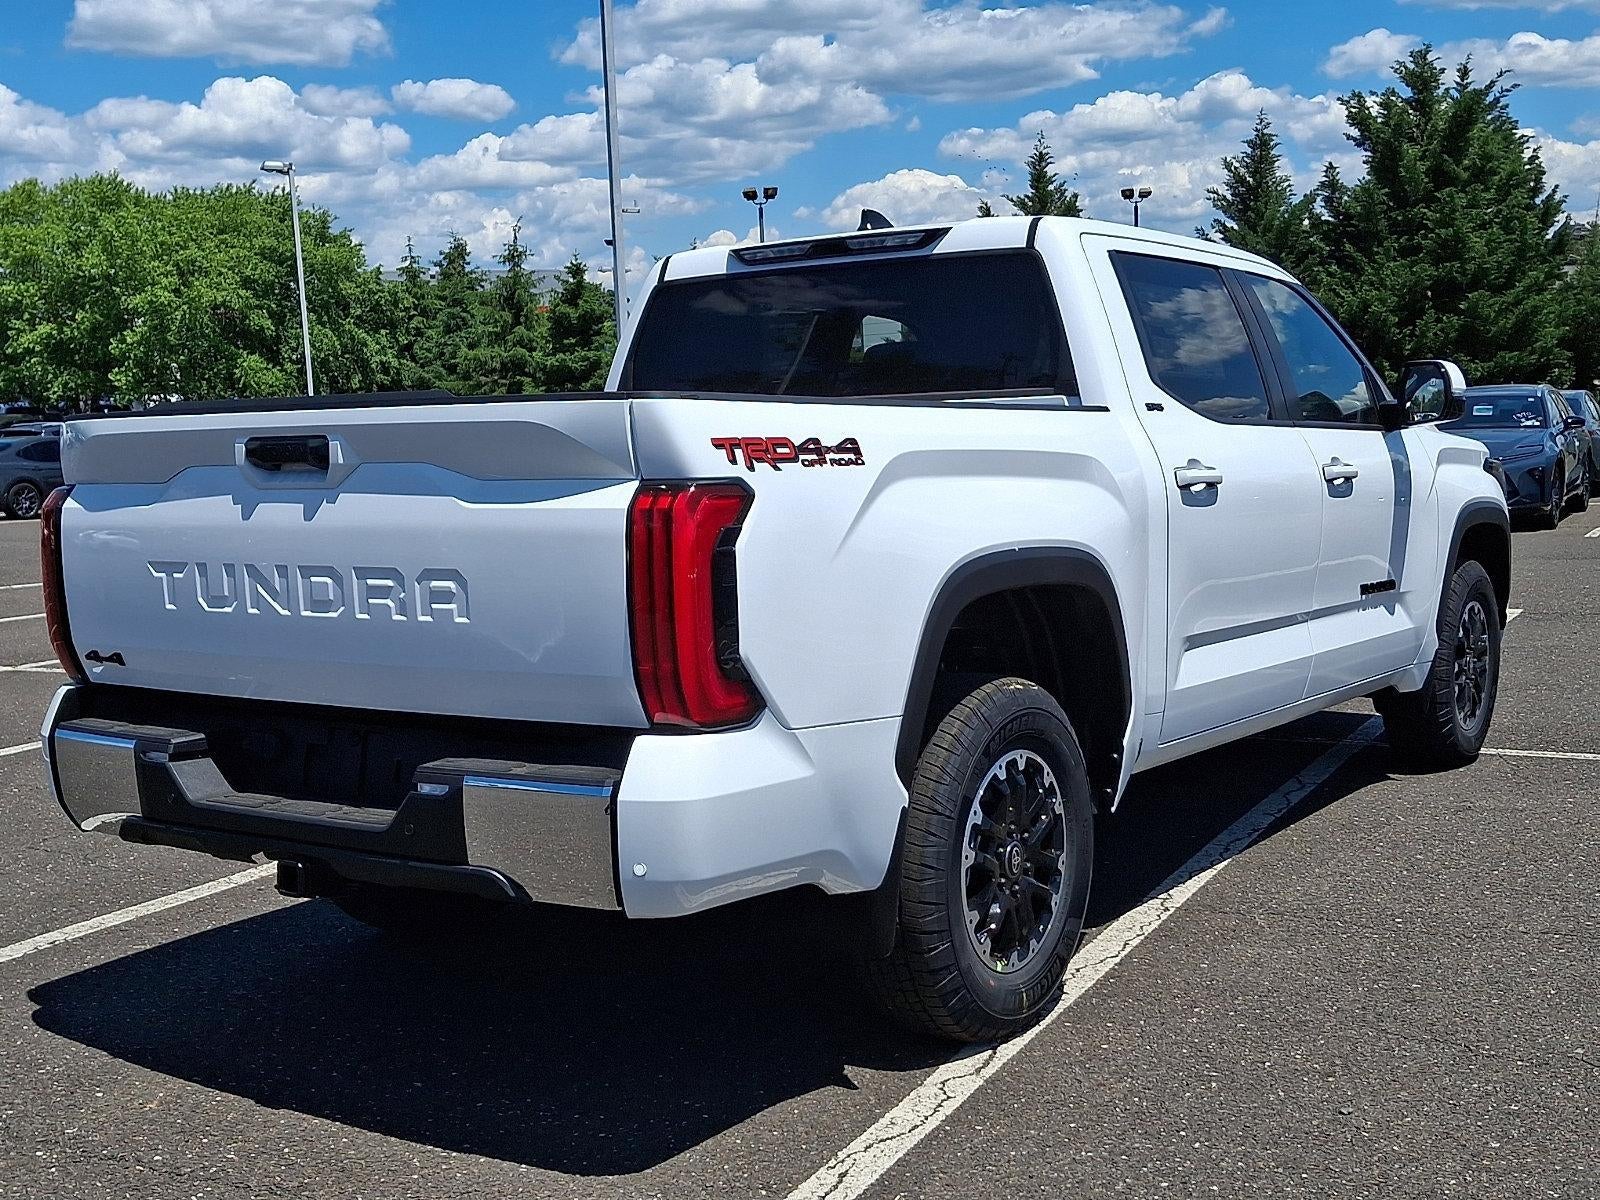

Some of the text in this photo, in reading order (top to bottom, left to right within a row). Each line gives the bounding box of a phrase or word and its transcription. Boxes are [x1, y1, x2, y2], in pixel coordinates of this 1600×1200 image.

[711, 437, 799, 472] TRD
[801, 457, 865, 467] OFF ROAD
[147, 560, 471, 623] TUNDRA
